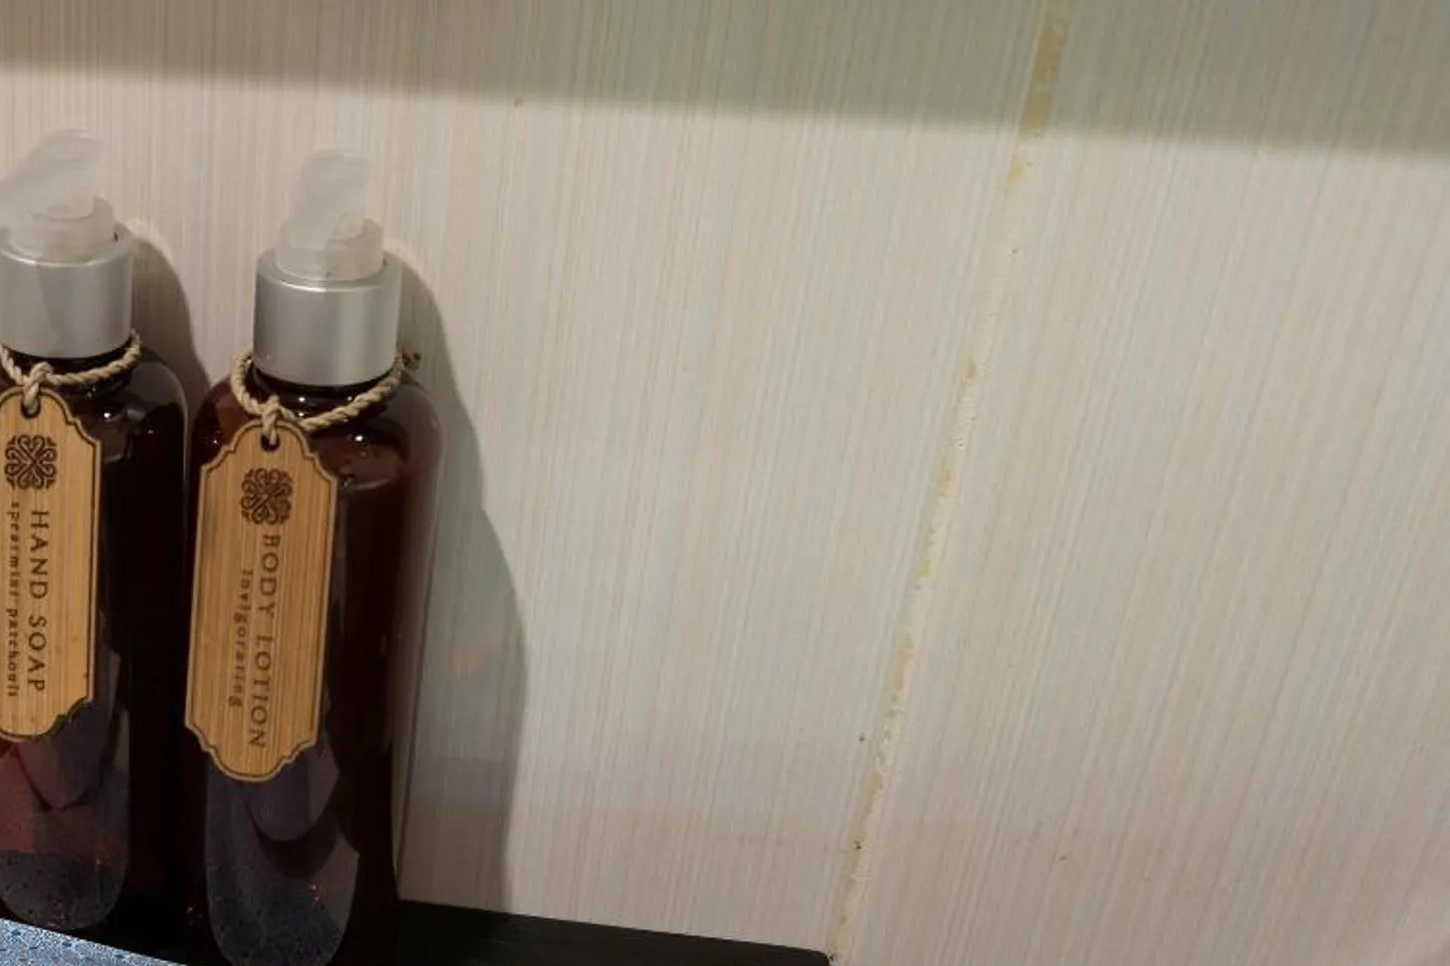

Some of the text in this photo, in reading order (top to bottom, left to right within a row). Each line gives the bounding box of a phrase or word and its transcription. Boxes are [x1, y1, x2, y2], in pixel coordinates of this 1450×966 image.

[27, 510, 49, 693] HAND SOAP
[249, 535, 280, 748] BODY LOTION
